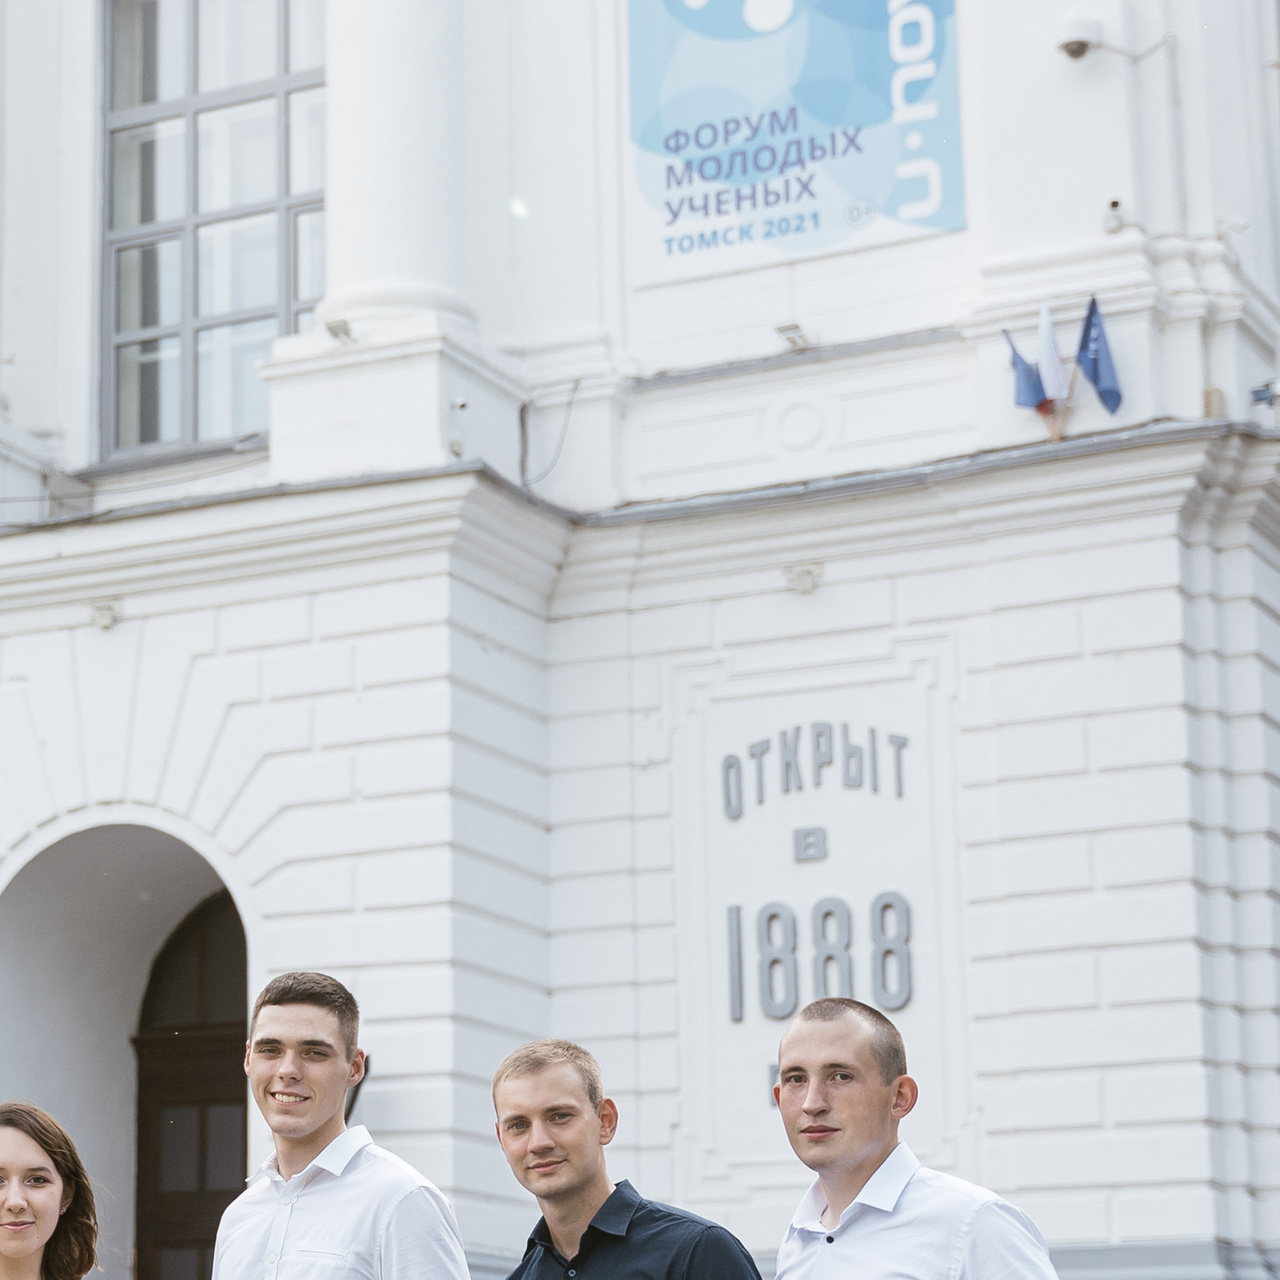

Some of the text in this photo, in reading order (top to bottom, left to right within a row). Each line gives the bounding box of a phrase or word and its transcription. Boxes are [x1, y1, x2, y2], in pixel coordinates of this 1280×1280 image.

[664, 107, 798, 155] ФОРУМ
[666, 127, 864, 191] МОЛОДЫХ
[665, 174, 817, 226] УЧЕНЫХ
[664, 212, 820, 256] ТОМСК 2021
[722, 722, 908, 820] ОТКРЫТ
[794, 827, 828, 863] В
[728, 891, 913, 1022] 1888
